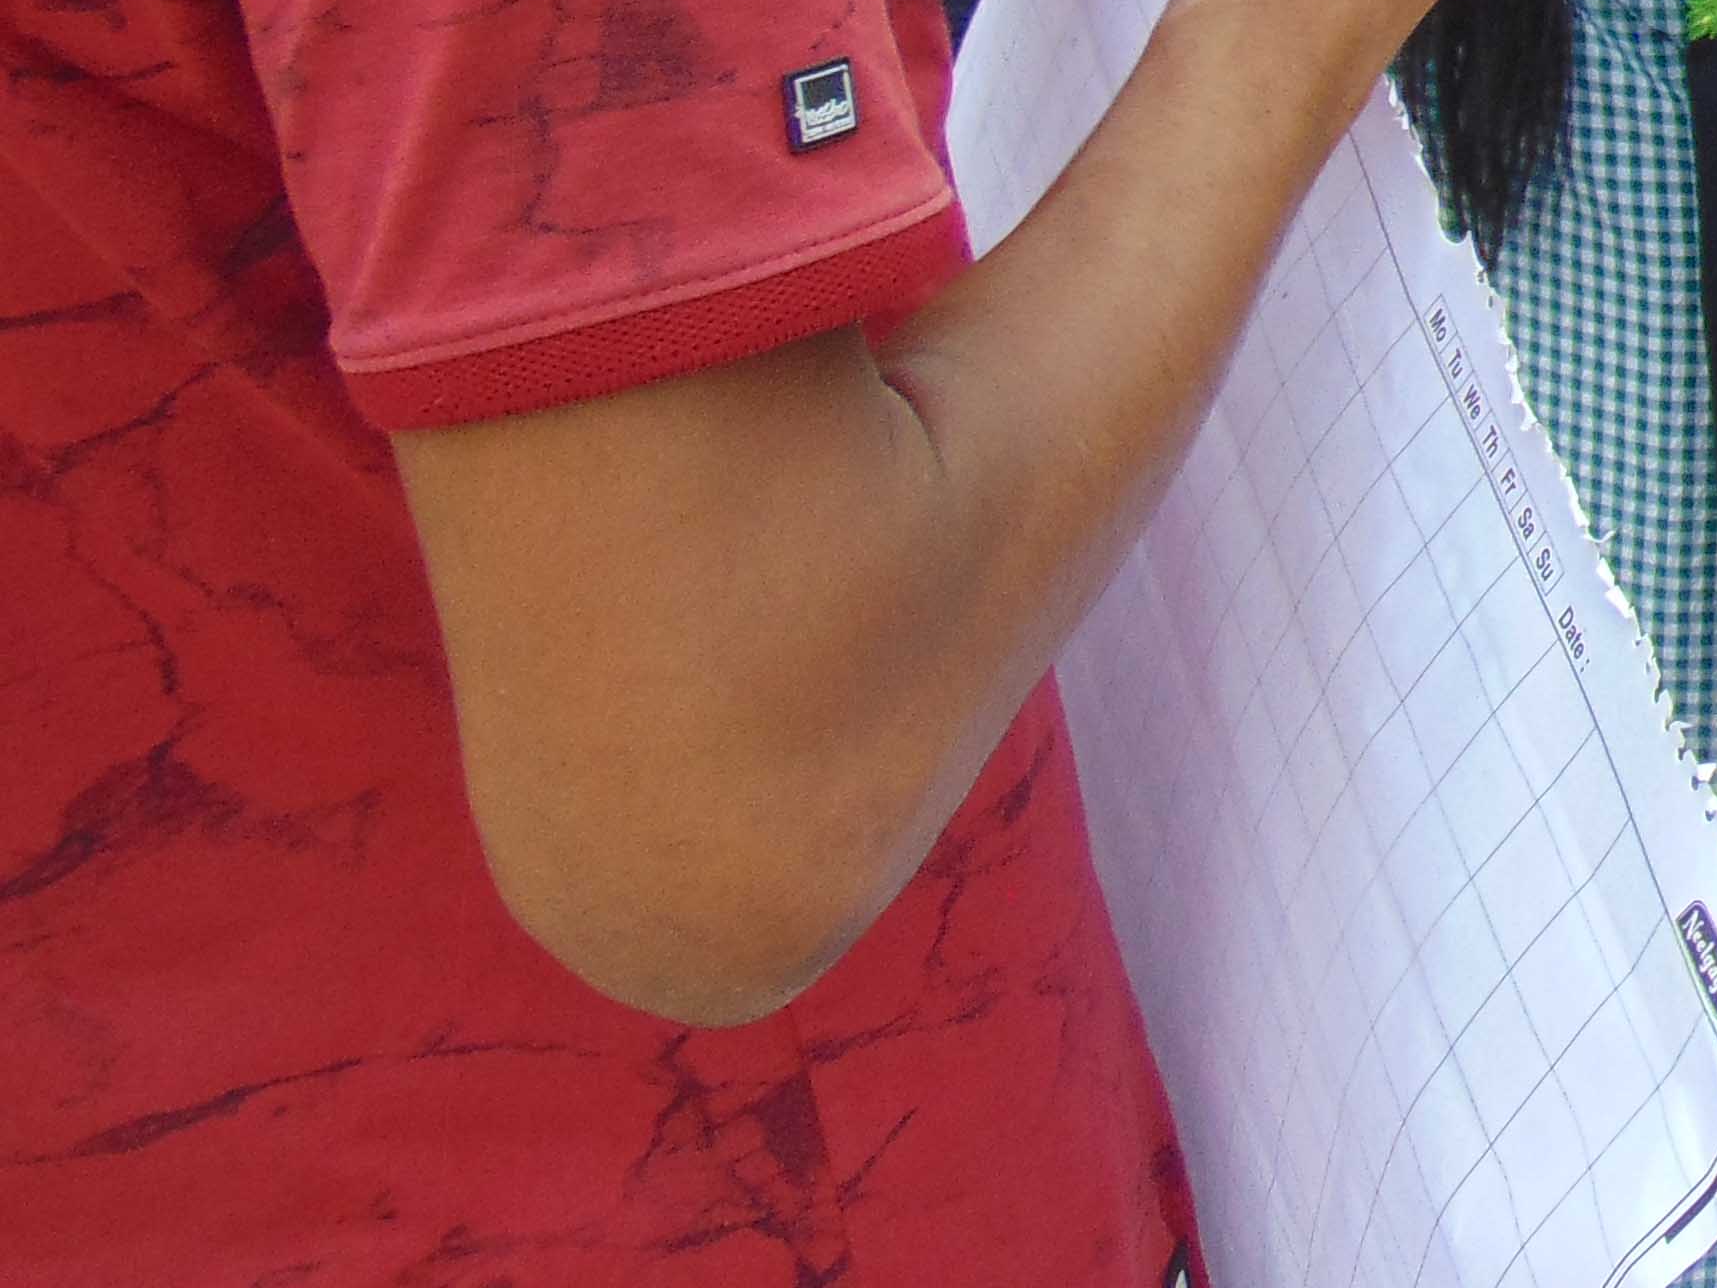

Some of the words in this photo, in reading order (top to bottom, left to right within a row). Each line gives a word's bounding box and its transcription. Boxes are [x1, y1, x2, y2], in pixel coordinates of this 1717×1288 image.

[1429, 308, 1447, 342] Mo
[1447, 348, 1463, 381] Tu
[1462, 384, 1481, 420] We
[1481, 425, 1498, 459] Th
[1501, 468, 1516, 497] Fr
[1517, 507, 1535, 541] Sa
[1536, 548, 1553, 582] Su
